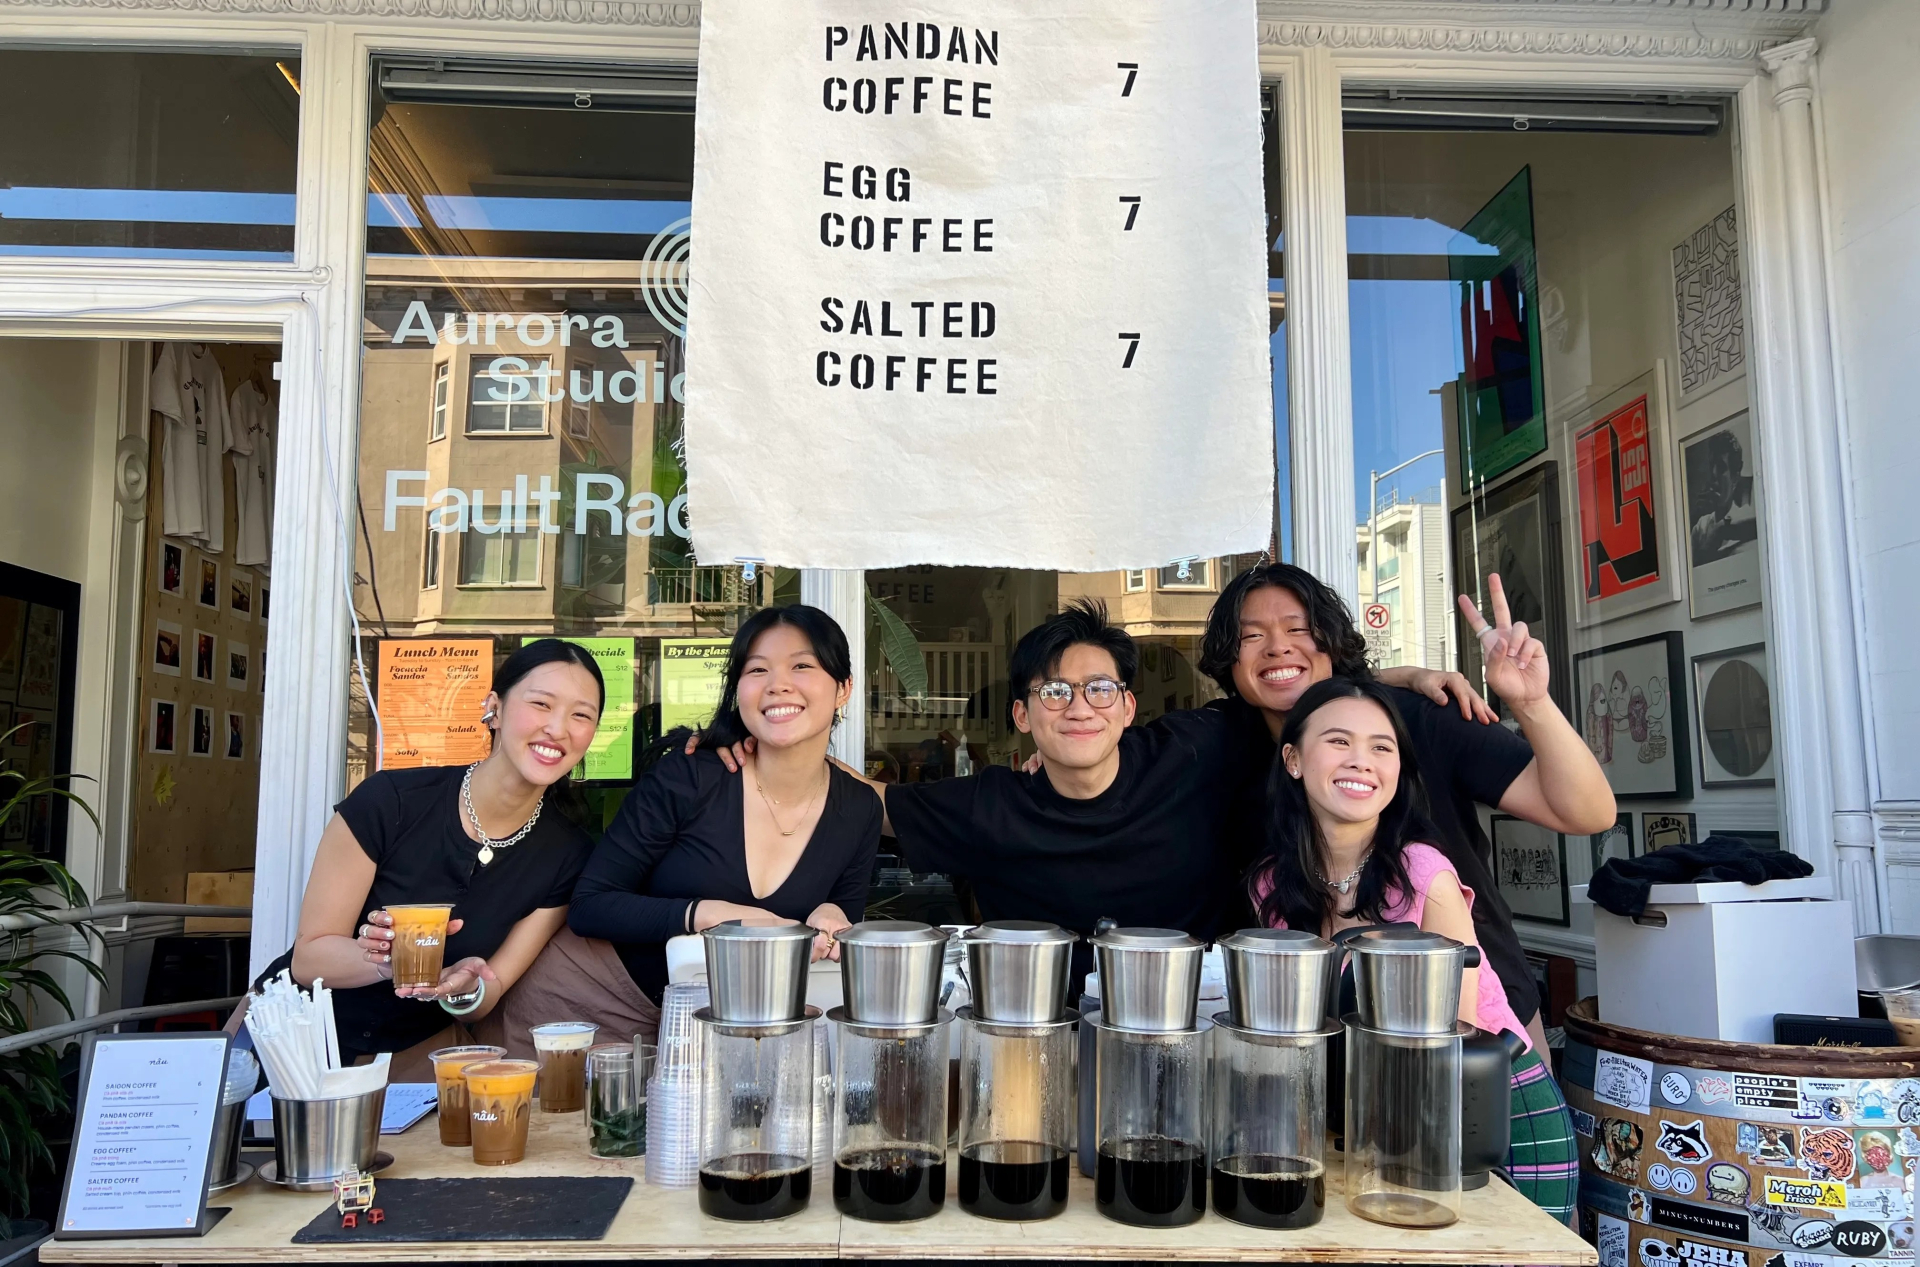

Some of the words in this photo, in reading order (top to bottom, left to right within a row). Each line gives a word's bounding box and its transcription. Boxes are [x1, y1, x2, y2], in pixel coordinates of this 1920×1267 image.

[826, 22, 998, 65] PANDAN
[1118, 63, 1139, 97] 7
[823, 77, 992, 118] COFFEE
[823, 162, 911, 202] EGG
[1119, 196, 1141, 231] 7
[820, 212, 994, 253] COFFEE
[820, 297, 996, 338] SALTED
[391, 300, 629, 348] Aurora
[1119, 333, 1141, 369] 7
[816, 351, 997, 395] COFFEE
[383, 470, 562, 535] Fault
[439, 647, 479, 657] Menu
[587, 648, 626, 657] pecials
[668, 647, 683, 658] By
[685, 646, 702, 656] the
[702, 646, 731, 658] glass
[389, 665, 428, 673] Focaccia
[446, 664, 479, 672] Grilled
[703, 661, 726, 670] Spri
[391, 672, 426, 680] Sandos
[445, 672, 479, 680] Sandos
[445, 725, 477, 733] Salads
[395, 749, 419, 757] Soup
[415, 936, 440, 946] nâu
[1662, 1075, 1684, 1099] GURO
[1735, 1076, 1789, 1087] people's
[1736, 1086, 1774, 1097] empty
[1736, 1096, 1770, 1107] place
[473, 1110, 498, 1121] nâu
[1770, 1180, 1822, 1197] Meroh
[1784, 1194, 1816, 1205] Frisco
[1836, 1231, 1881, 1247] RUBY
[1677, 1240, 1748, 1267] JEHA
